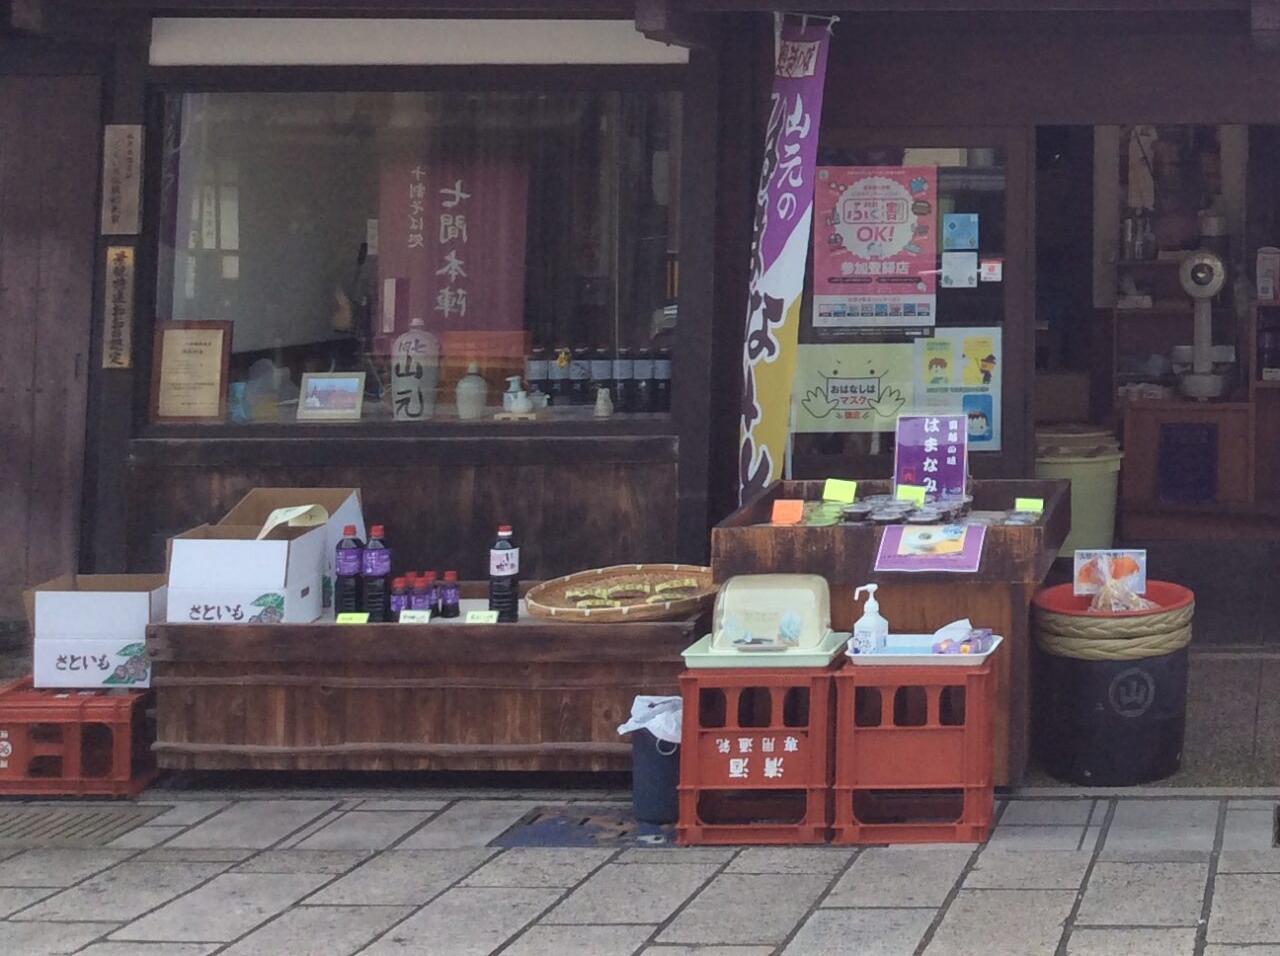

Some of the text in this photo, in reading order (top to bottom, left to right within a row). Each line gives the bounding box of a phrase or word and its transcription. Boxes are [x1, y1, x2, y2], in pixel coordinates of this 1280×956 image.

[777, 93, 811, 221] 山元の
[856, 226, 895, 242] OK!
[841, 261, 909, 275] 参加登録店
[395, 355, 424, 418] 山元
[830, 385, 876, 394] おはなしは
[840, 396, 867, 405] マスク
[189, 604, 245, 621] さといも
[55, 654, 110, 671] さといも
[728, 757, 784, 779] 清酒
